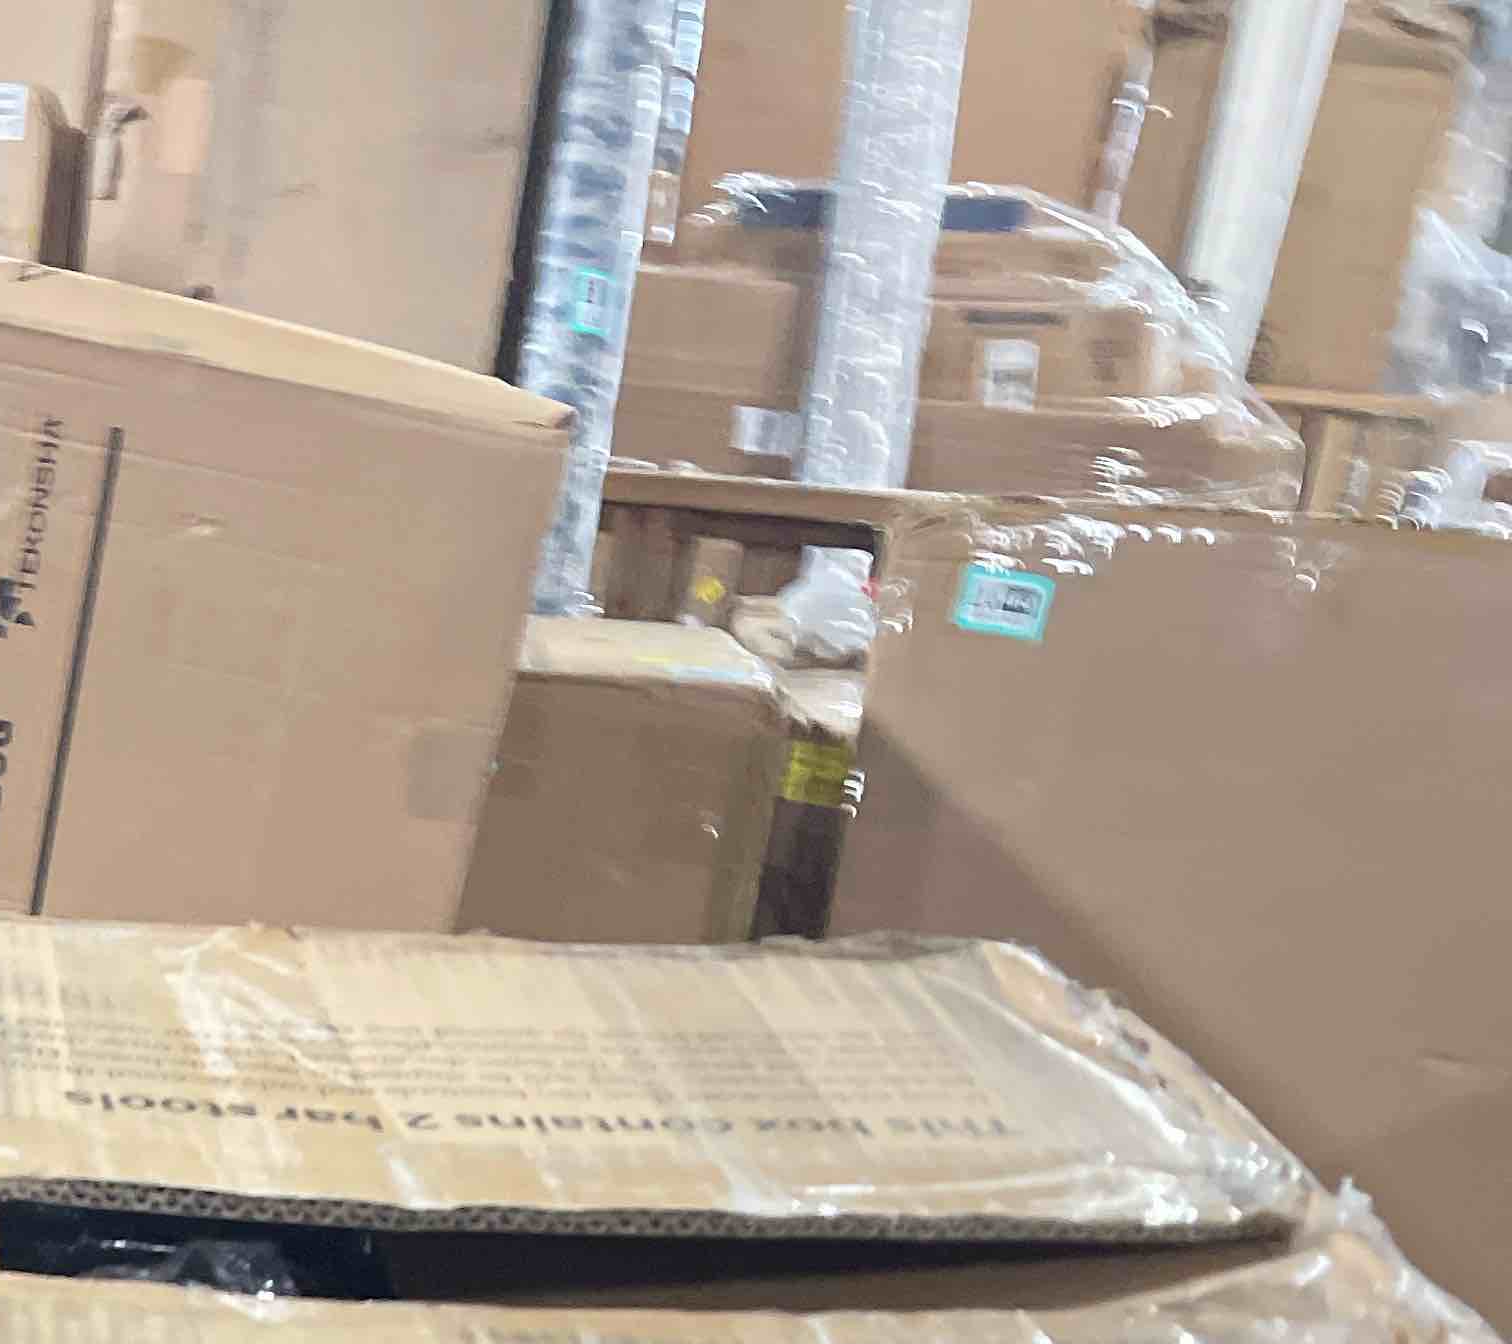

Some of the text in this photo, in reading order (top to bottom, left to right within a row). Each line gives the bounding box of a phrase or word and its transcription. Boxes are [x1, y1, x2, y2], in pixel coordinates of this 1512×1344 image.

[64, 1089, 259, 1118] stools
[275, 1106, 384, 1132] bar
[402, 1112, 440, 1131] 2
